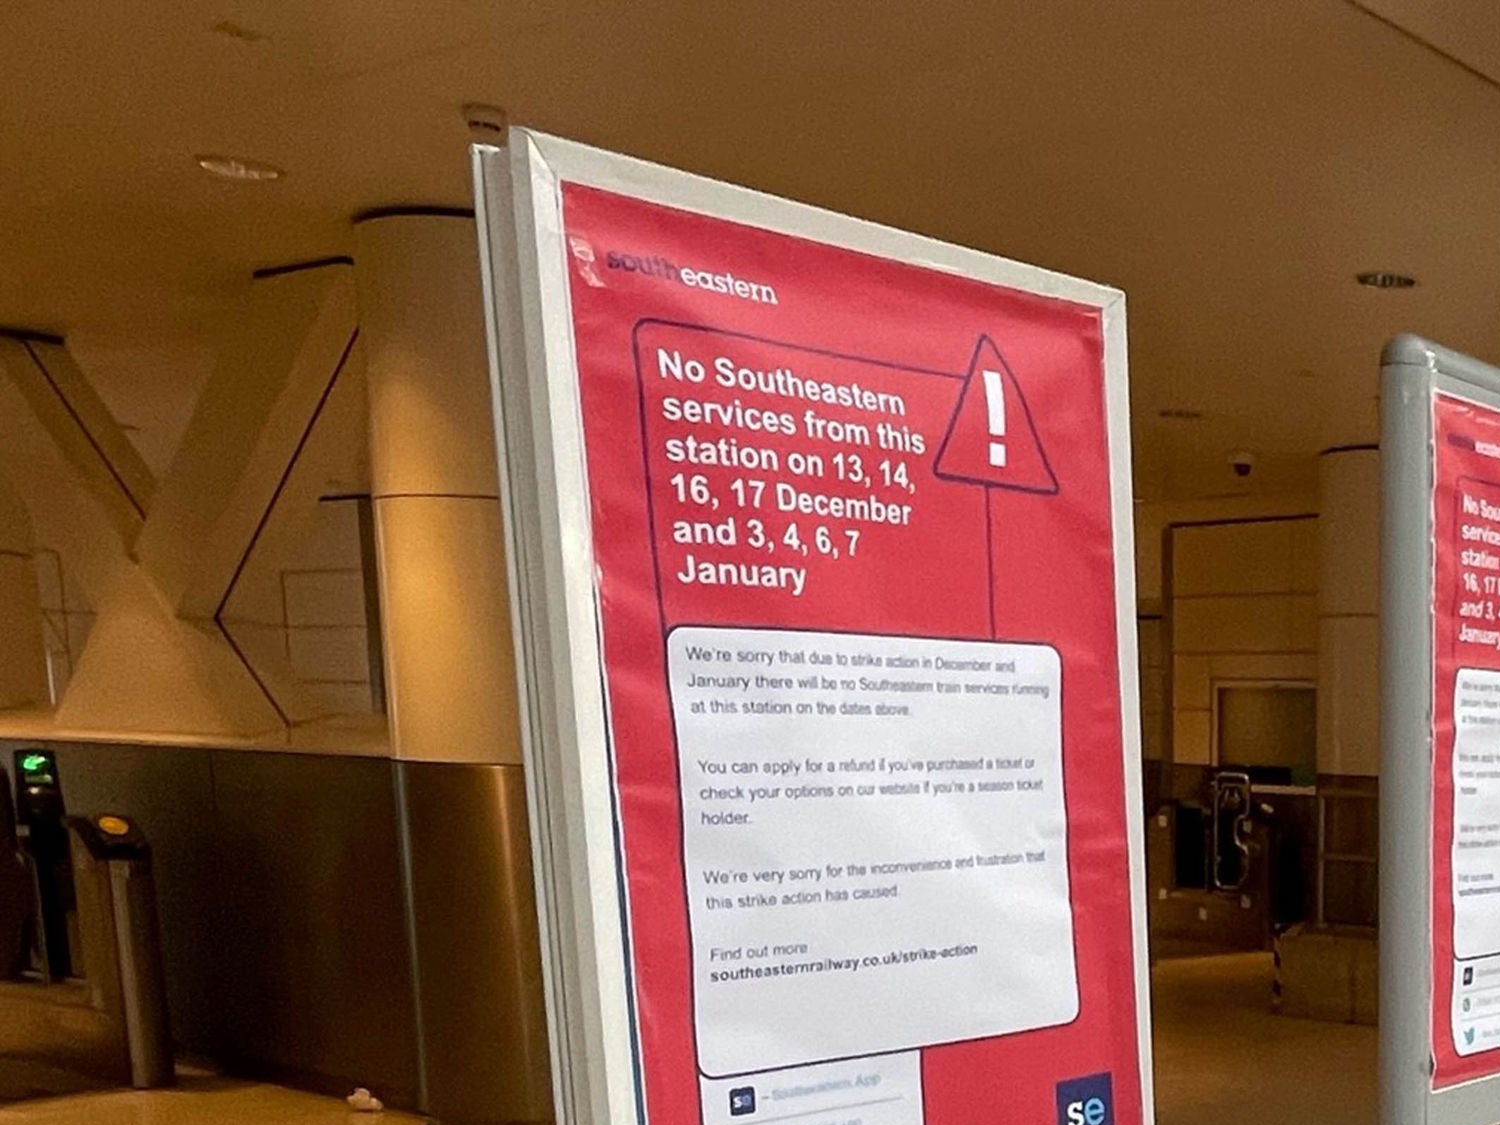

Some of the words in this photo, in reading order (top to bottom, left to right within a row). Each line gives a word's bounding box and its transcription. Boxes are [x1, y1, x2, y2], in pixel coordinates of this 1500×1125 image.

[606, 251, 778, 304] southeastern
[657, 349, 704, 383] No
[716, 358, 905, 416] Southeastern
[662, 396, 796, 436] services
[803, 412, 870, 445] from
[876, 425, 926, 455] this
[665, 437, 779, 472] station
[787, 452, 824, 477] on
[833, 454, 871, 488] 13,
[878, 460, 916, 493] 14,
[671, 473, 719, 511] 16,
[731, 480, 765, 508] 17
[777, 484, 912, 526] December
[1463, 495, 1478, 515] No
[673, 518, 736, 547] and
[747, 520, 775, 553] 3,
[783, 524, 808, 555] 4,
[816, 528, 839, 557] 6,
[846, 531, 860, 556] 7
[1461, 549, 1499, 569] station
[677, 556, 806, 596] January
[1485, 576, 1497, 593] 17
[1460, 601, 1483, 618] and
[685, 646, 732, 663] We're
[737, 652, 775, 666] sorry
[779, 650, 805, 664] that
[809, 652, 832, 665] due
[836, 654, 848, 666] to
[851, 654, 882, 667] strike
[886, 656, 919, 669] action
[922, 656, 932, 669] in
[687, 674, 750, 691] January
[755, 676, 793, 689] there
[798, 677, 818, 689] will
[821, 678, 837, 690] be
[841, 681, 856, 691] no
[859, 677, 933, 693] Southeastern
[936, 682, 961, 693] train
[691, 702, 706, 714] at
[710, 700, 738, 714] this
[742, 700, 792, 714] station
[796, 703, 813, 714] on
[817, 702, 836, 715] the
[698, 760, 727, 774] You
[731, 762, 758, 774] can
[763, 760, 800, 776] apply
[805, 759, 822, 773] for
[827, 762, 835, 773] a
[700, 786, 744, 800] check
[750, 787, 780, 802] your
[785, 786, 834, 800] options
[837, 786, 853, 797] on
[857, 785, 875, 796] our
[703, 870, 748, 884] We're
[753, 871, 784, 884] very
[789, 869, 822, 882] sorry
[826, 865, 843, 877] for
[847, 865, 867, 876] the
[706, 897, 733, 910] this
[738, 895, 777, 908] strike
[782, 892, 822, 905] action
[826, 889, 848, 901] has
[710, 947, 742, 962] Find
[747, 946, 768, 959] out
[773, 944, 808, 956] more
